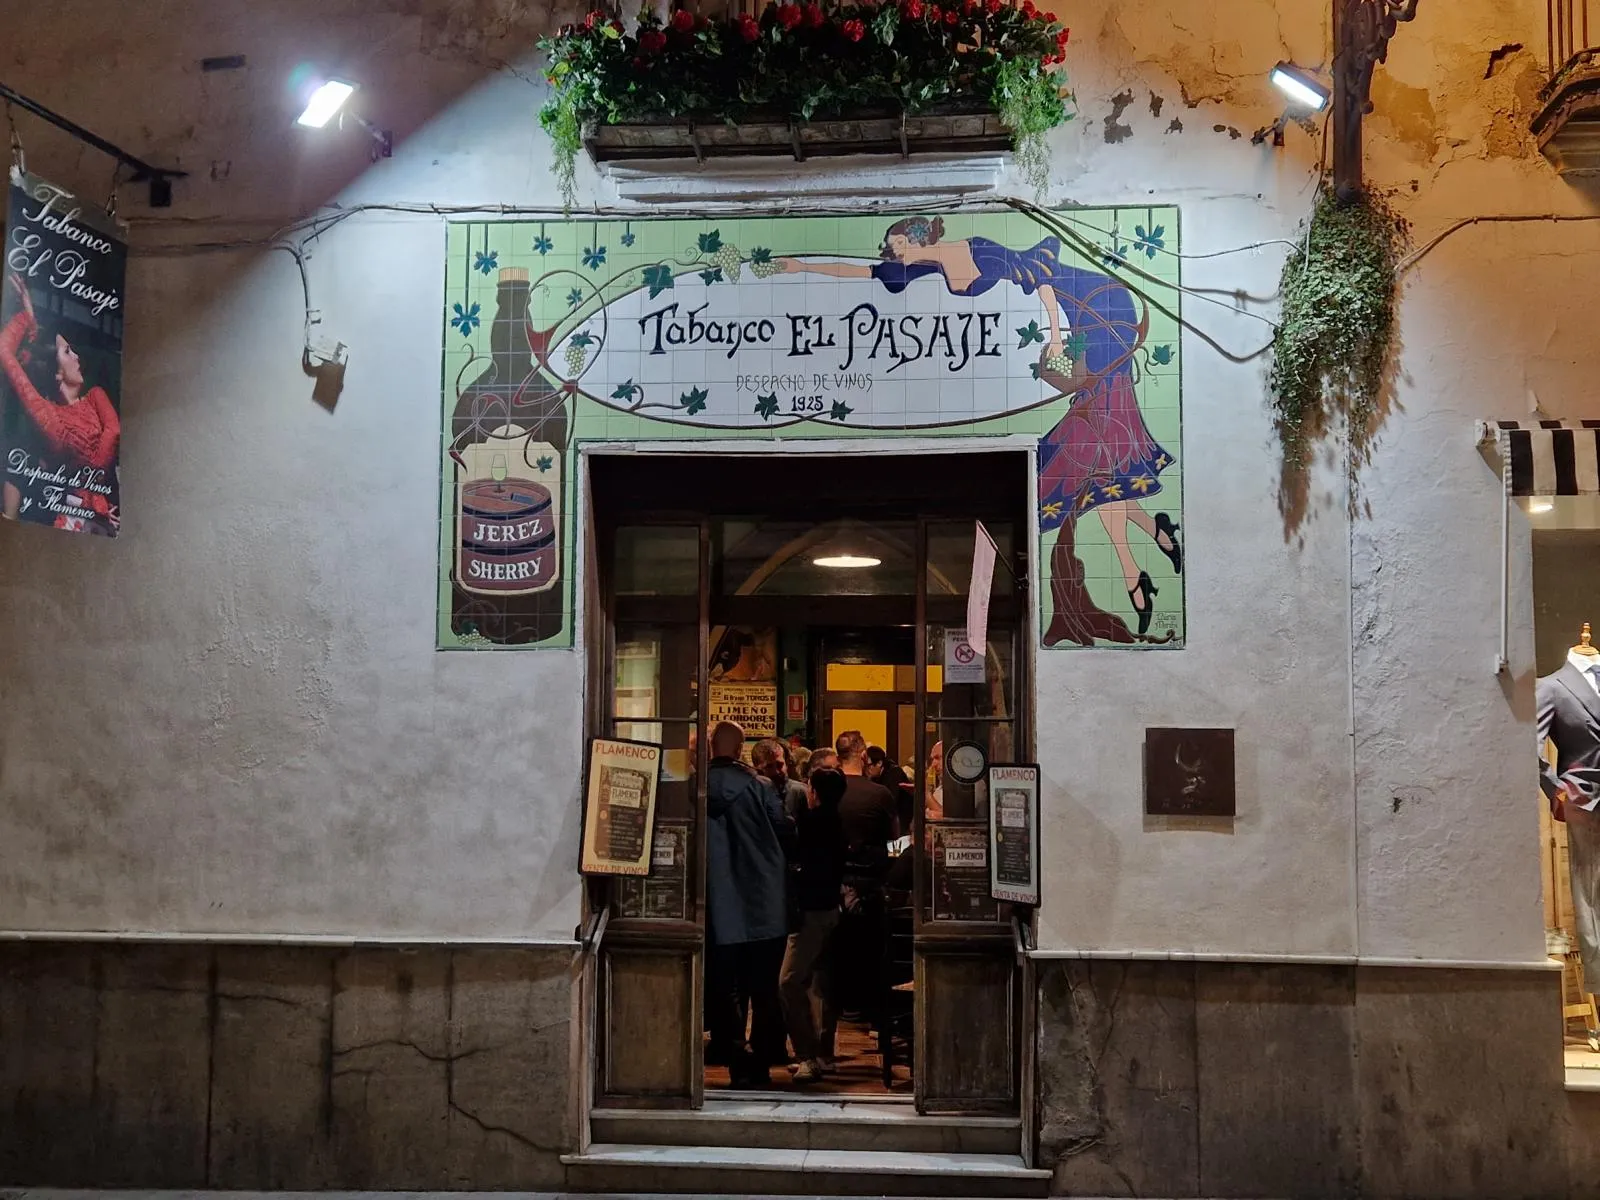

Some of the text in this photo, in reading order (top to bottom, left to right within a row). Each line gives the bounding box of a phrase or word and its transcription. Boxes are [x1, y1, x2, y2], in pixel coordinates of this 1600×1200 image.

[22, 184, 112, 254] Tabanco
[8, 226, 120, 316] El Pasaje
[638, 302, 1002, 374] Tabanco EL PASAJE
[736, 372, 874, 393] DESPACHO DE VINOS
[790, 395, 824, 412] 1925
[7, 448, 113, 495] Despacho de Vinos
[19, 485, 96, 519] y Flamenco
[473, 518, 543, 542] JEREZ
[468, 556, 542, 580] SHERRY
[719, 705, 768, 714] LIMEÑO
[595, 742, 657, 761] FLAMENCO
[992, 769, 1036, 782] FLAMENCO
